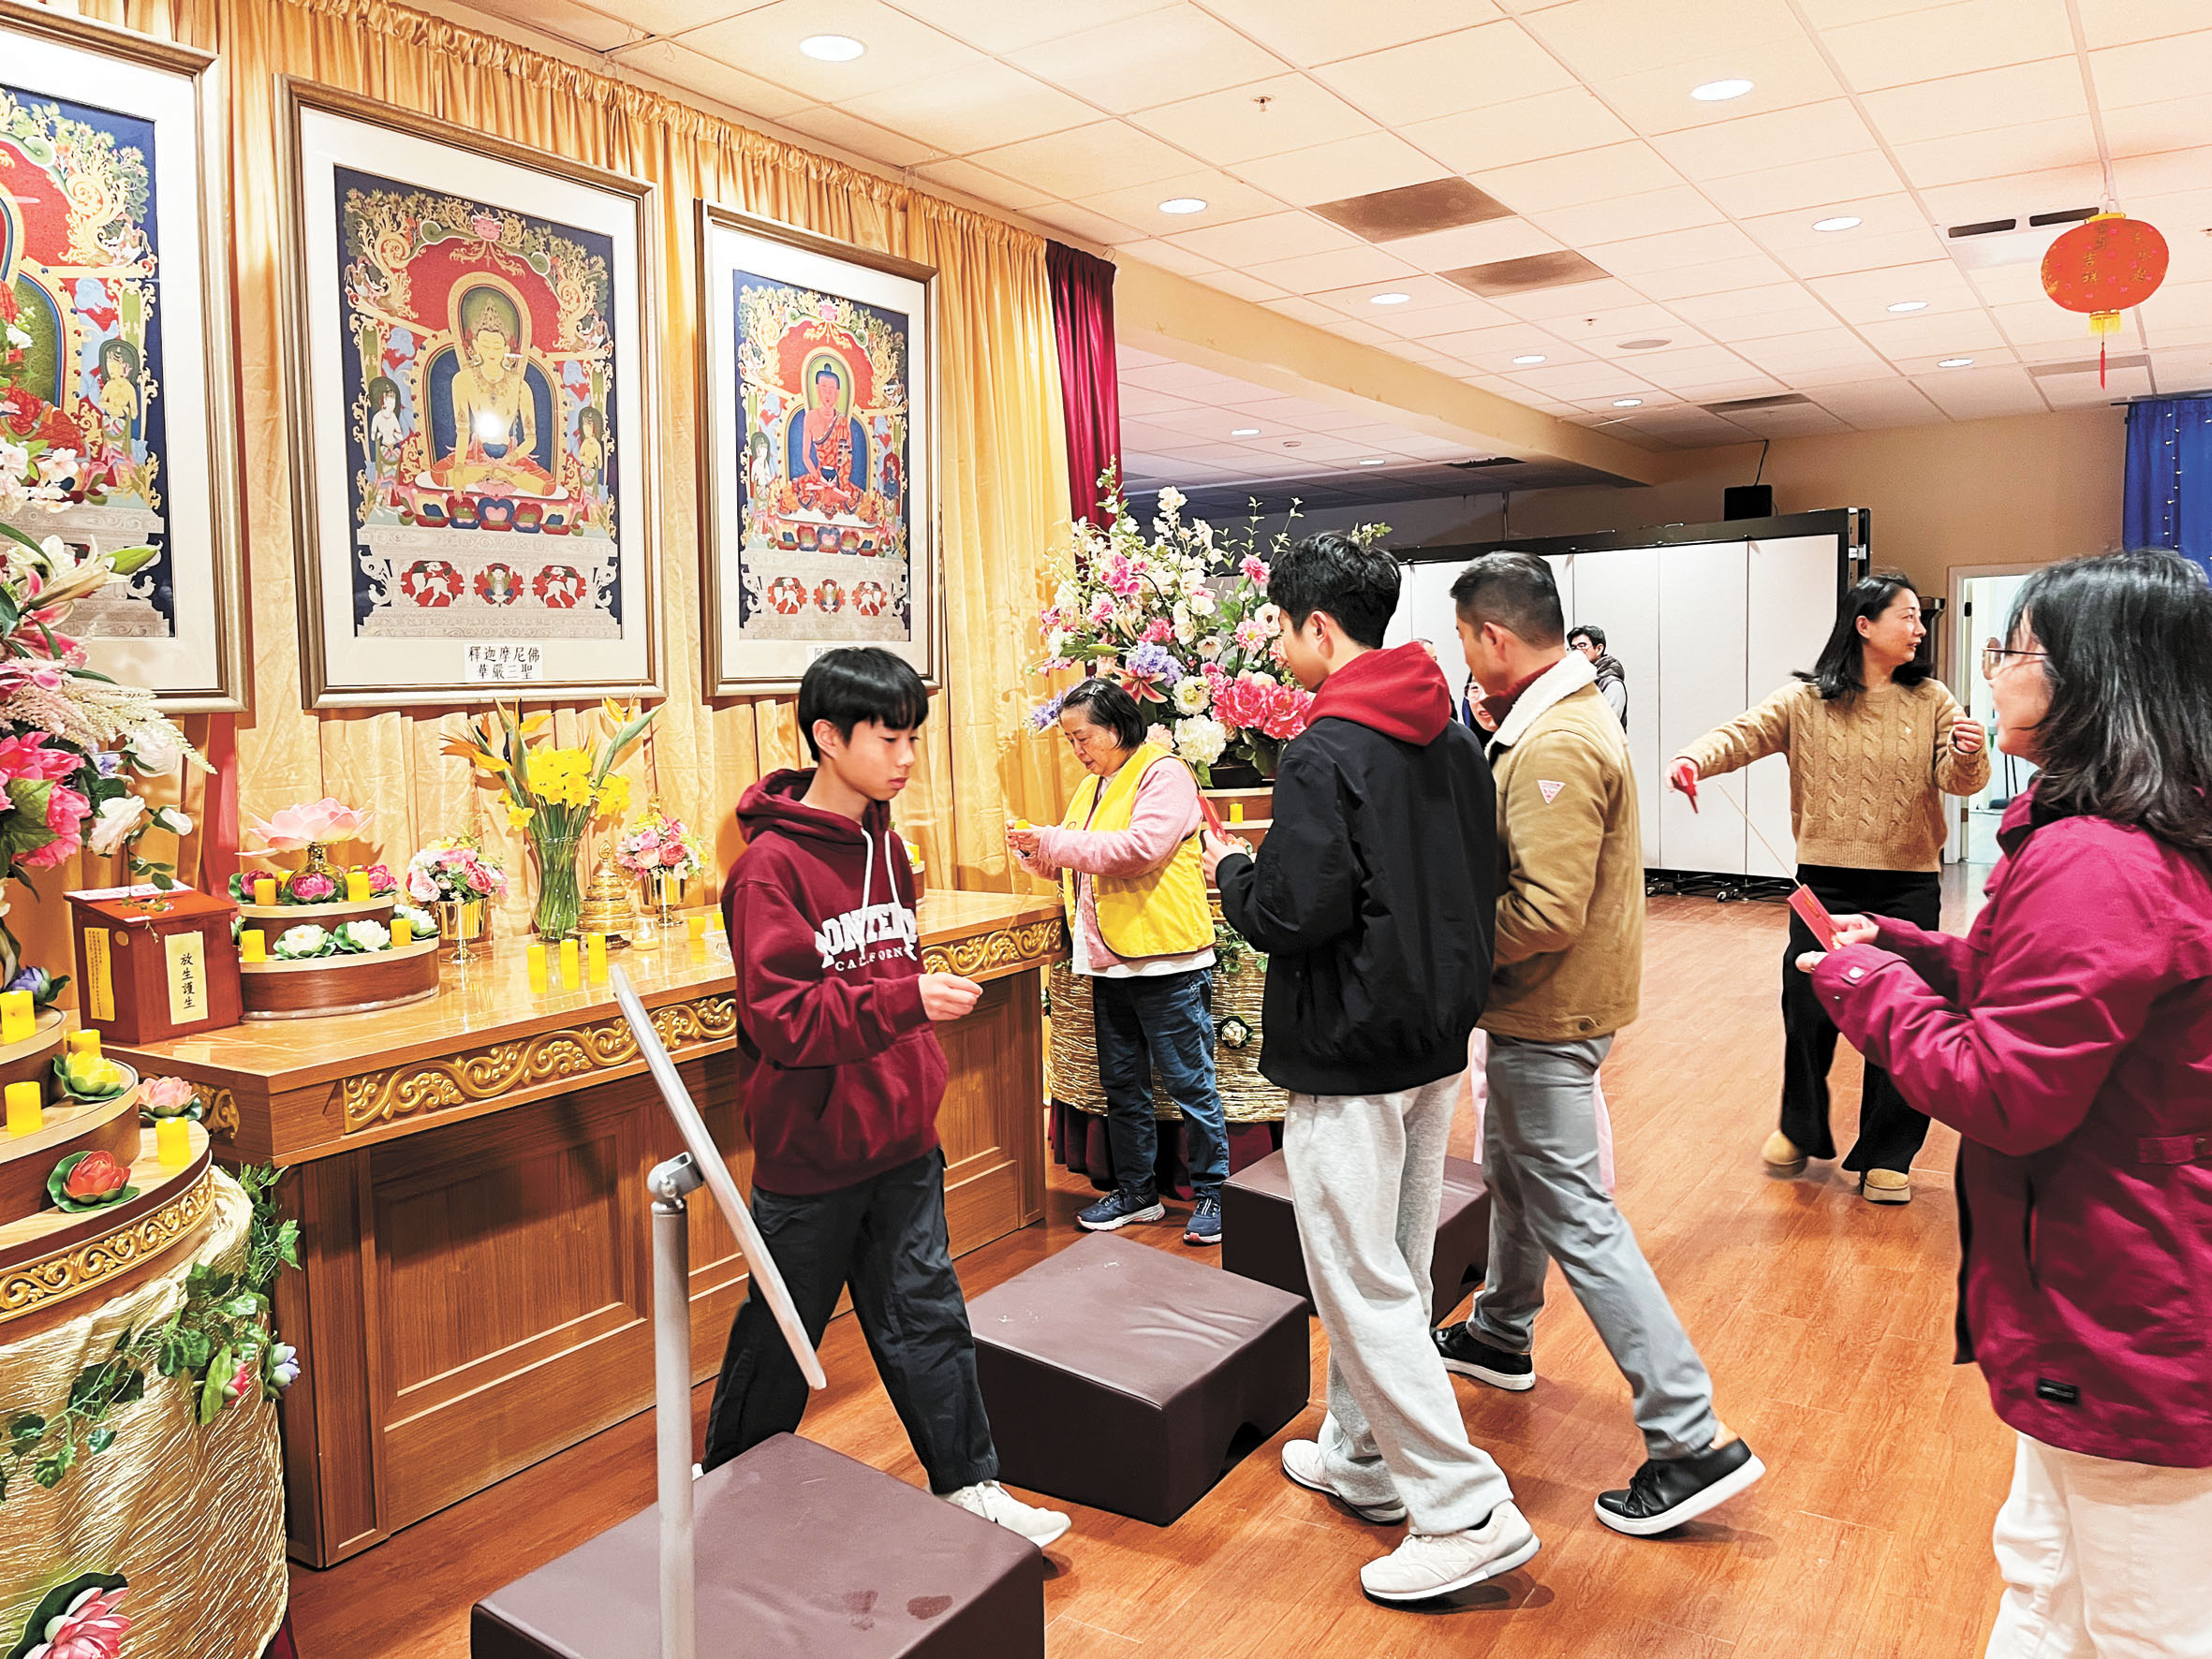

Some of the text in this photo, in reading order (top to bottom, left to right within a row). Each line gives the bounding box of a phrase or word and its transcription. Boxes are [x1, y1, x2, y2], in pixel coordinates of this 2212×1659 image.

[468, 646, 540, 663] 釋迦摩尼佛
[479, 663, 533, 680] 華嚴三聖
[180, 953, 196, 1009] 放生護生
